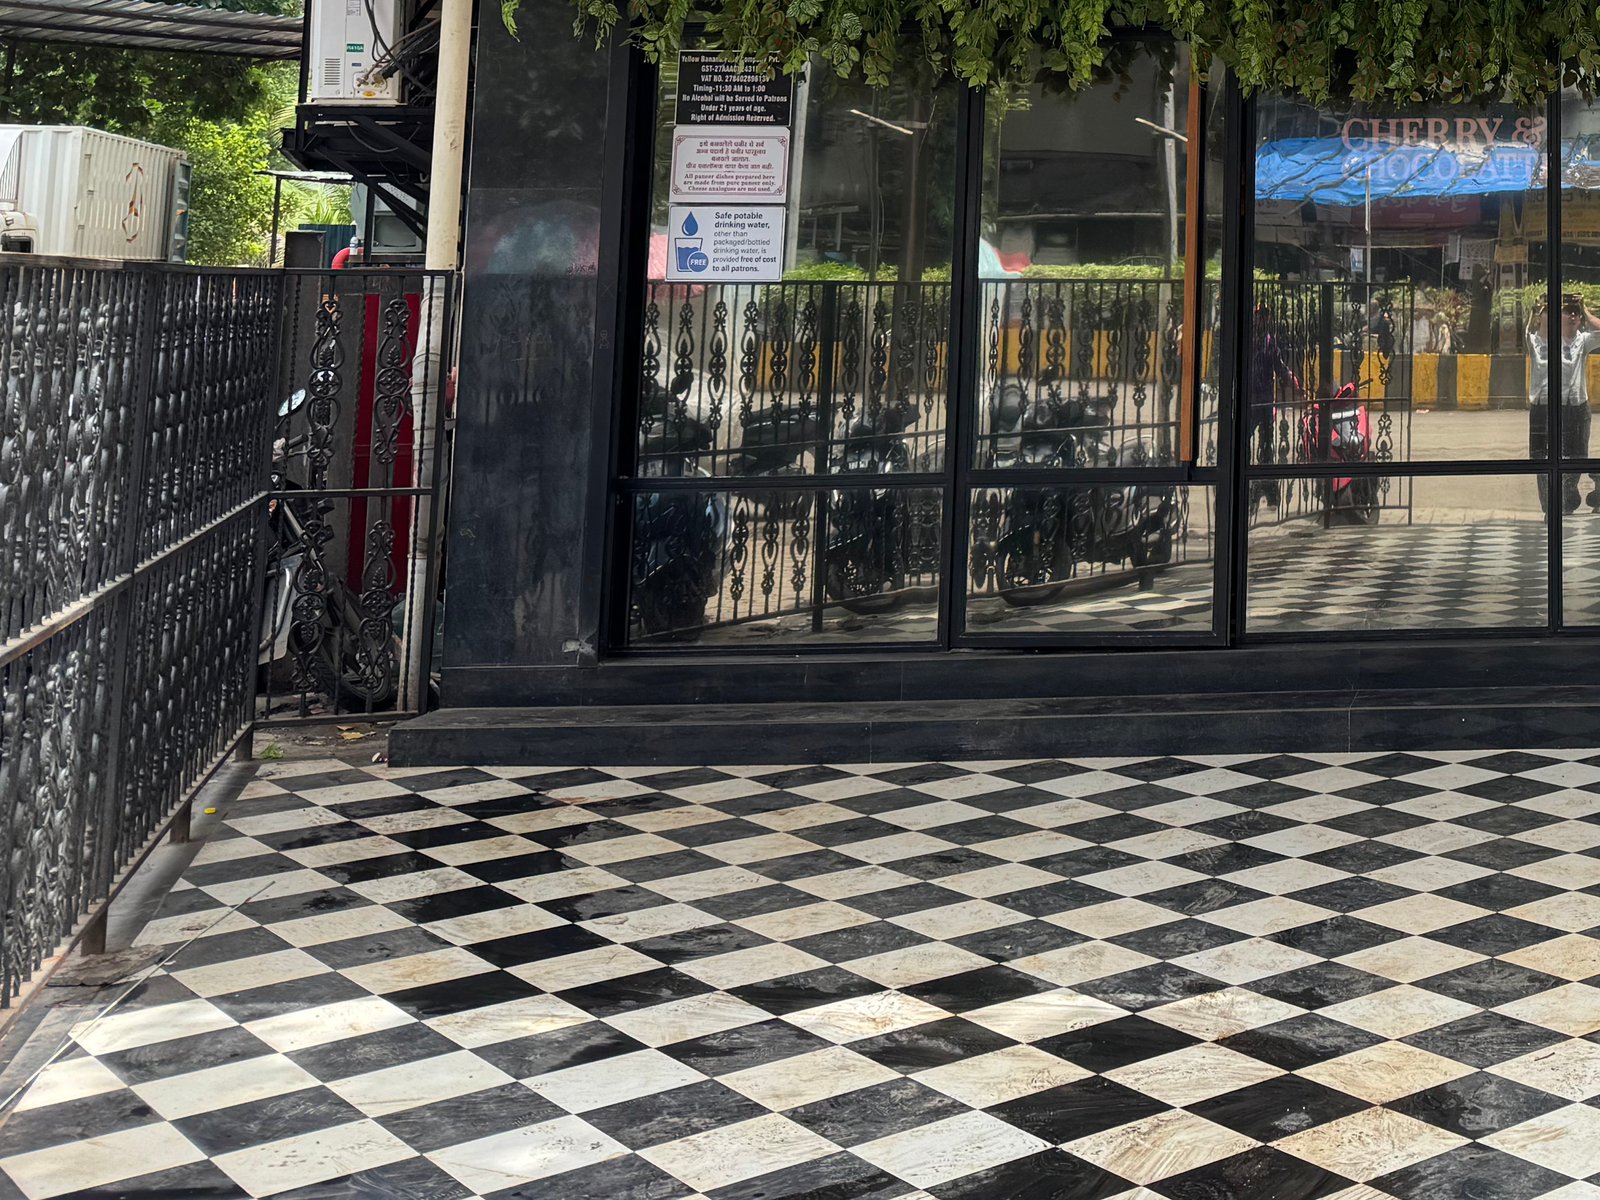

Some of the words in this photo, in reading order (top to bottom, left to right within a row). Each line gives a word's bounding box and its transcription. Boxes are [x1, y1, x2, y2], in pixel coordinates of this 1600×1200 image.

[681, 55, 700, 63] Yellow
[682, 94, 690, 102] No
[691, 94, 714, 102] Alcohol
[715, 94, 725, 102] will
[726, 94, 733, 102] be
[700, 104, 718, 112] Under
[728, 105, 744, 113] years
[753, 105, 766, 114] age.
[690, 113, 707, 122] Right
[707, 114, 714, 122] of
[715, 114, 745, 122] Admission
[746, 114, 776, 122] Reserved.
[1341, 116, 1504, 152] CHERRY
[1512, 116, 1547, 150] &
[714, 211, 732, 220] Safe
[733, 211, 763, 222] potable
[714, 221, 746, 230] drinking
[747, 222, 770, 230] water,
[713, 238, 771, 247] packaged/bottled
[713, 247, 739, 255] drinking
[690, 258, 707, 266] FREE
[712, 255, 740, 264] provided
[731, 265, 759, 273] patrons.
